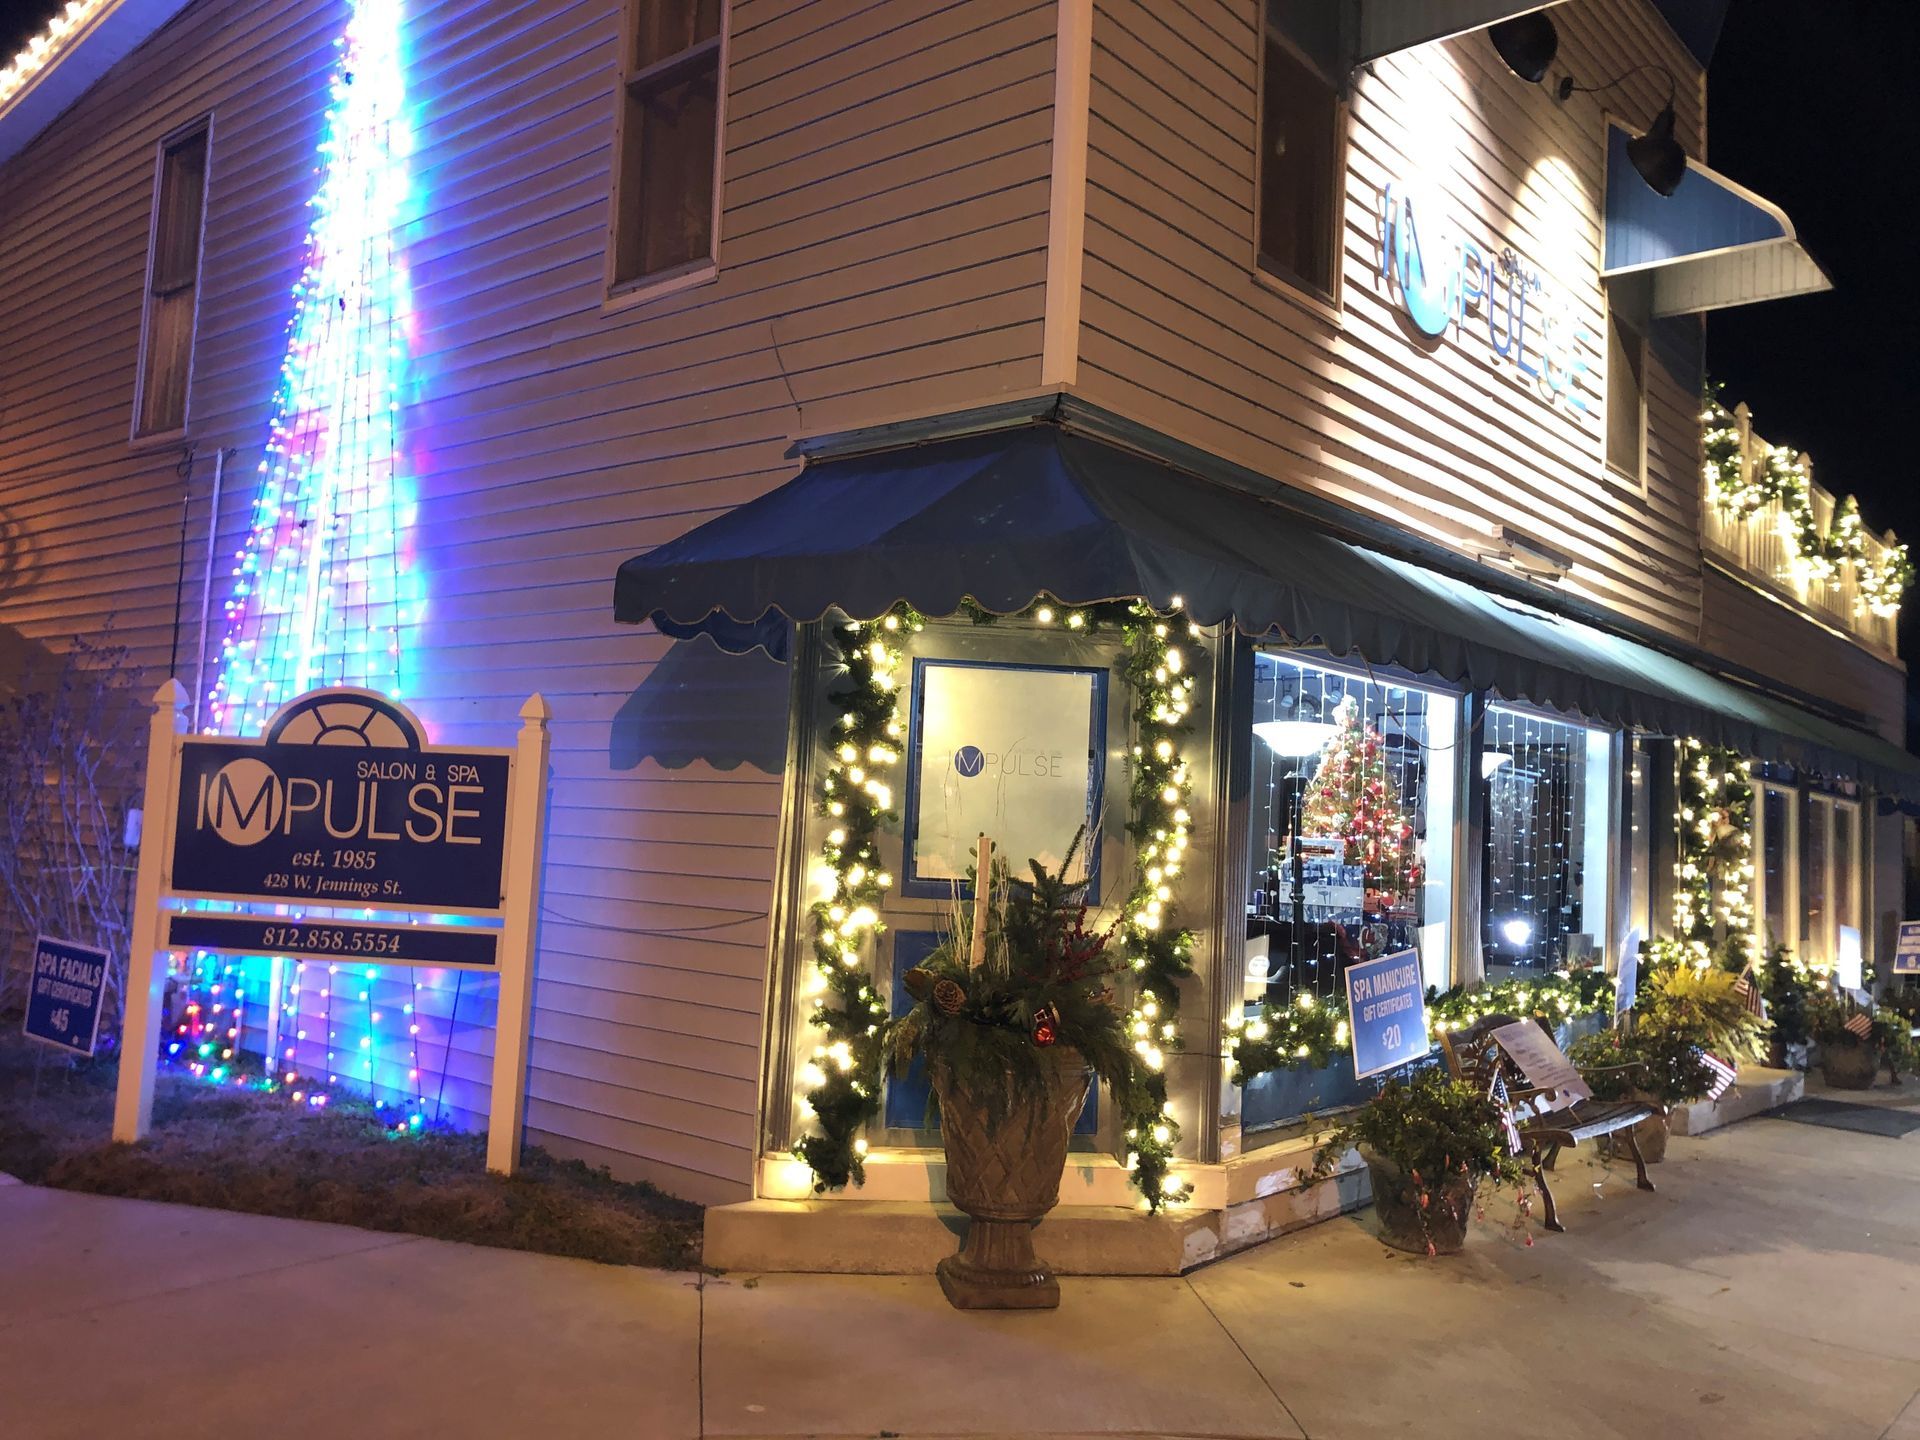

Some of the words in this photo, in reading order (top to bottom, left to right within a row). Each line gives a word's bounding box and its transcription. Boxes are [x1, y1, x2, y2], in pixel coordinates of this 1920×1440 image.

[357, 760, 416, 780] SALON
[425, 763, 436, 781] &
[447, 764, 480, 783] SPA
[197, 758, 484, 845] IMPULSE
[292, 850, 325, 867] est.
[332, 849, 377, 870] 1985
[263, 873, 289, 888] 428
[293, 875, 312, 890] W.
[315, 875, 379, 898] Jennings
[383, 879, 402, 896] St.
[263, 927, 400, 953] 812.858.5554
[38, 952, 57, 976] SPA
[59, 957, 102, 987] FACIALS
[1354, 978, 1372, 1002] SPA
[1374, 964, 1416, 995] MANICURE
[1364, 1005, 1377, 1022] GIFT
[1382, 1024, 1401, 1050] $20
